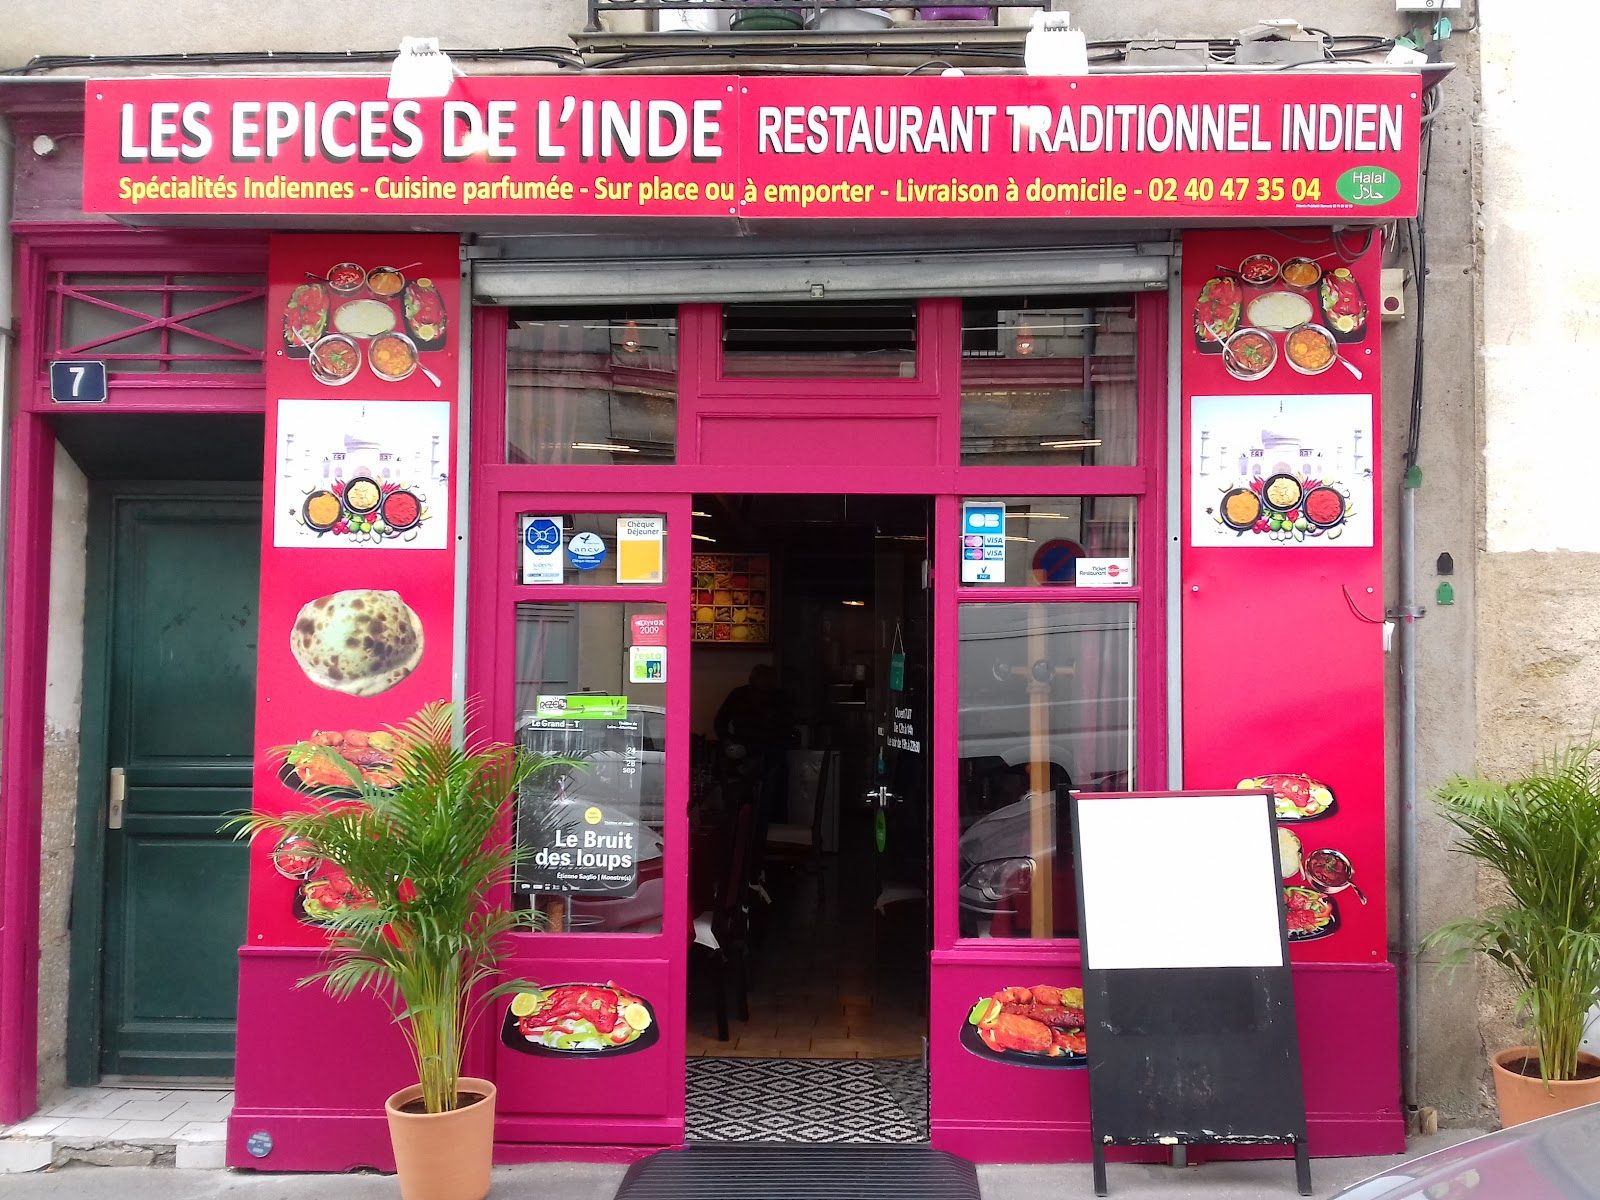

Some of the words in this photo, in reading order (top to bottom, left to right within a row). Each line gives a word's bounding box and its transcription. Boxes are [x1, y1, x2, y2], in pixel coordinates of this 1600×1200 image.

[120, 101, 213, 160] LES
[230, 100, 423, 161] EPICES
[442, 100, 517, 160] DE
[537, 96, 722, 161] L'INDE
[758, 105, 997, 153] RESTAURANT
[1005, 104, 1272, 152] TRADITIONNEL
[1282, 103, 1403, 152] INDIEN
[1353, 171, 1386, 184] Halal
[119, 175, 237, 204] Spécialités
[244, 176, 354, 200] Indiennes
[374, 176, 456, 200] Cuisine
[463, 175, 574, 204] parfumée
[594, 176, 632, 200] Sur
[639, 176, 698, 205] place
[705, 182, 734, 201] ou
[744, 178, 757, 202] à
[764, 180, 874, 207] emporter
[896, 178, 998, 202] Livraison
[1006, 177, 1019, 202] à
[1026, 177, 1127, 202] domicile
[1149, 177, 1178, 201] 02
[1184, 177, 1214, 201] 40
[1220, 177, 1249, 201] 47
[1256, 177, 1285, 201] 35
[1291, 177, 1321, 201] 04
[1353, 184, 1384, 200] حلال
[69, 367, 85, 397] 7
[627, 521, 655, 529] Chèque
[969, 513, 1000, 528] CB
[627, 528, 660, 536] Déjeuner
[639, 626, 660, 635] 2009
[531, 720, 541, 728] Le
[541, 720, 565, 728] Grand
[574, 720, 580, 728] T
[622, 767, 636, 775] sep
[555, 830, 579, 848] Le
[584, 830, 633, 849] Bruit
[535, 848, 571, 866] des
[576, 849, 632, 872] loups
